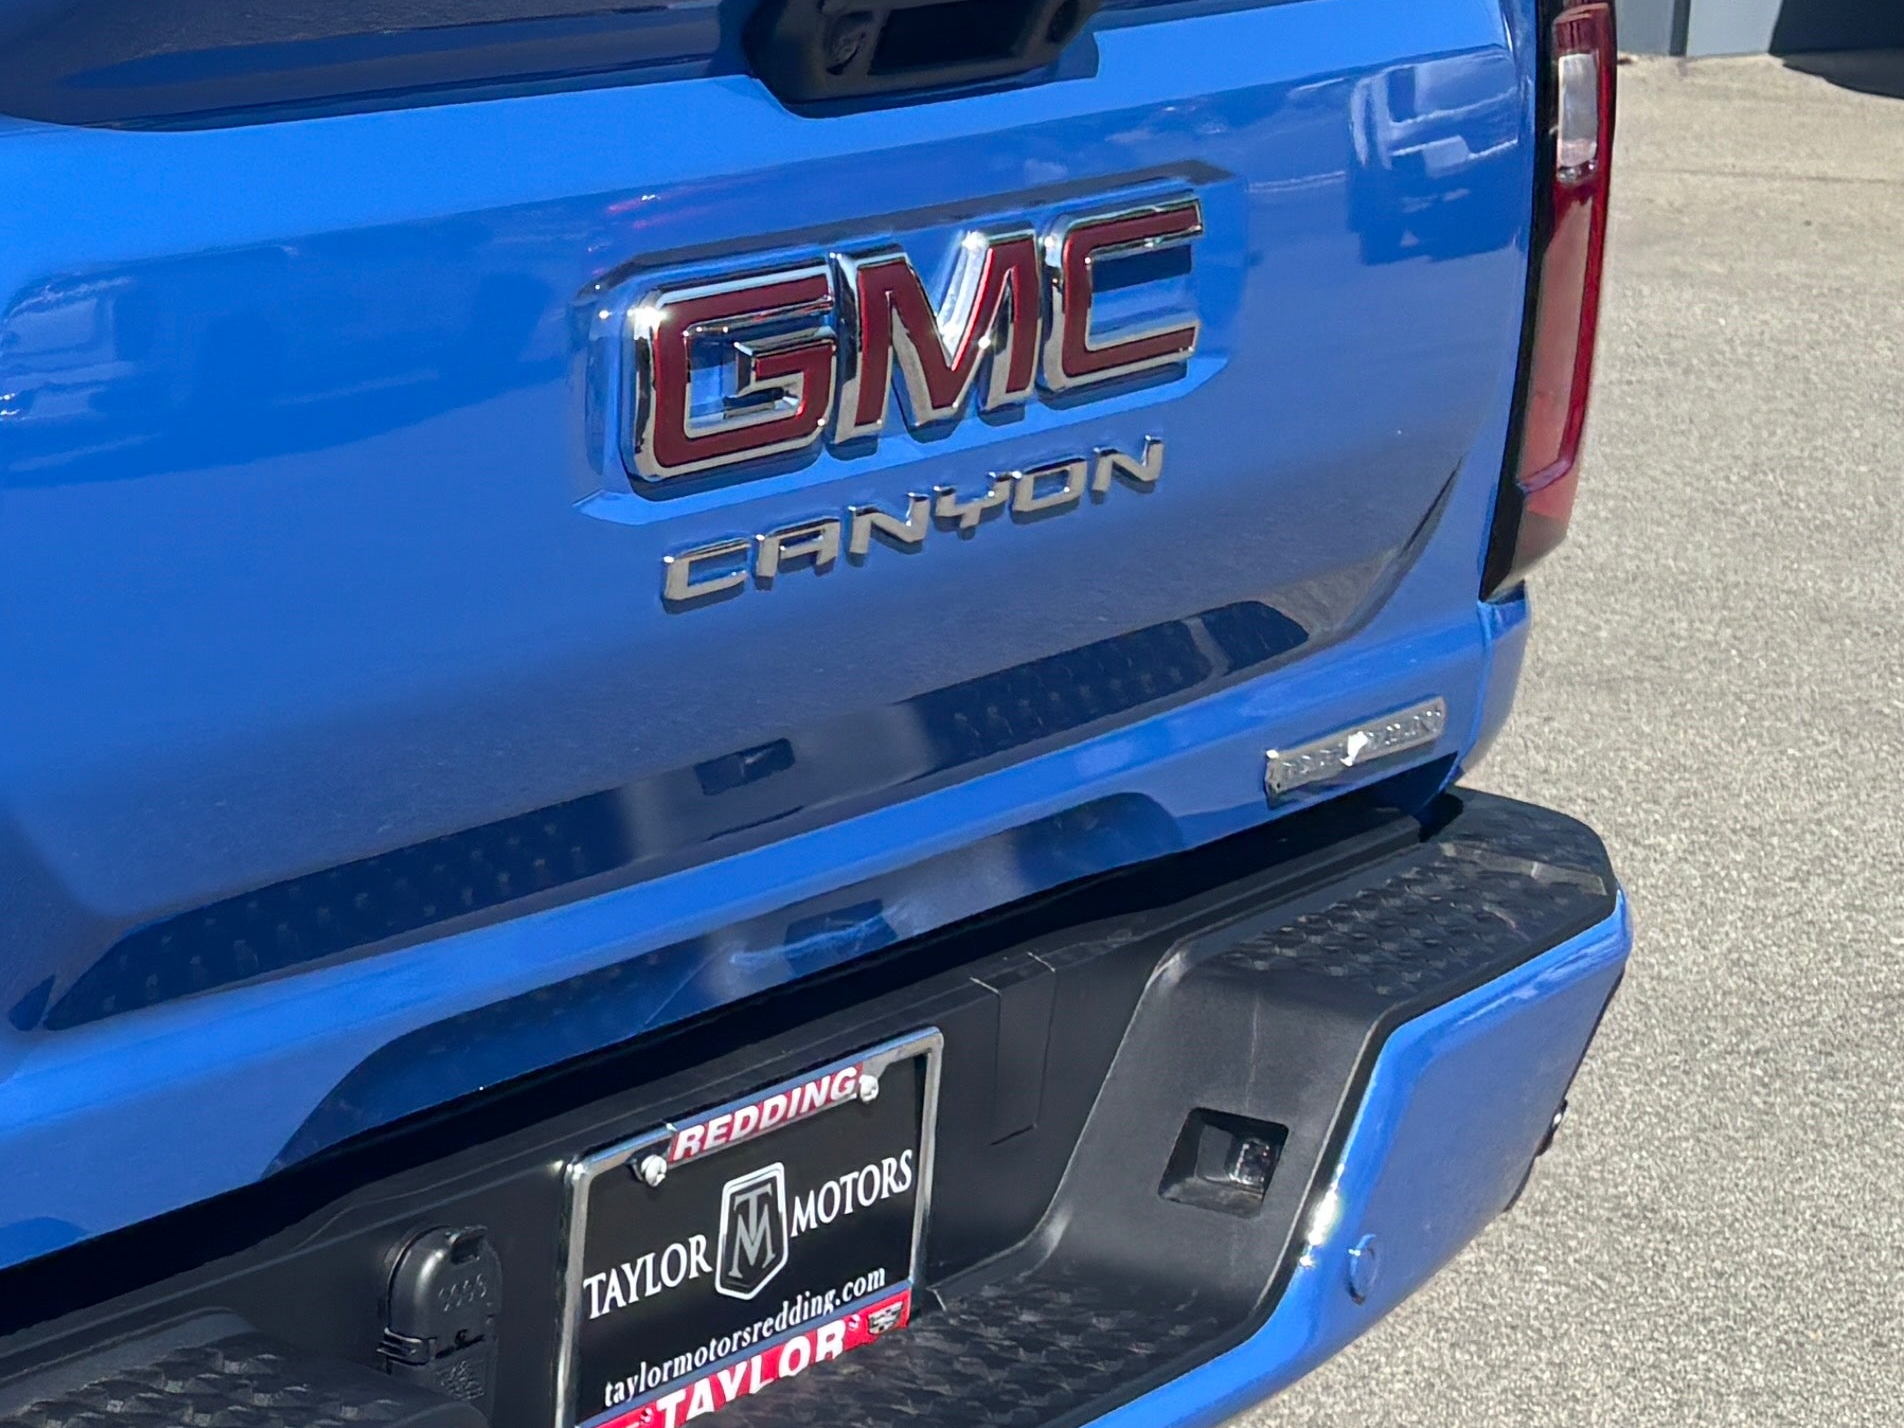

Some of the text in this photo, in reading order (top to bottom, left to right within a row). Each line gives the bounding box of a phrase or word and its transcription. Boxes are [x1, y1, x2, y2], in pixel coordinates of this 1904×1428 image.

[627, 194, 1204, 487] GMC
[662, 434, 1166, 610] CANYON
[672, 1065, 860, 1162] REDDING
[583, 1148, 913, 1320] TAYLOR MOTORS
[604, 1265, 886, 1408] taylormotorsredding.com
